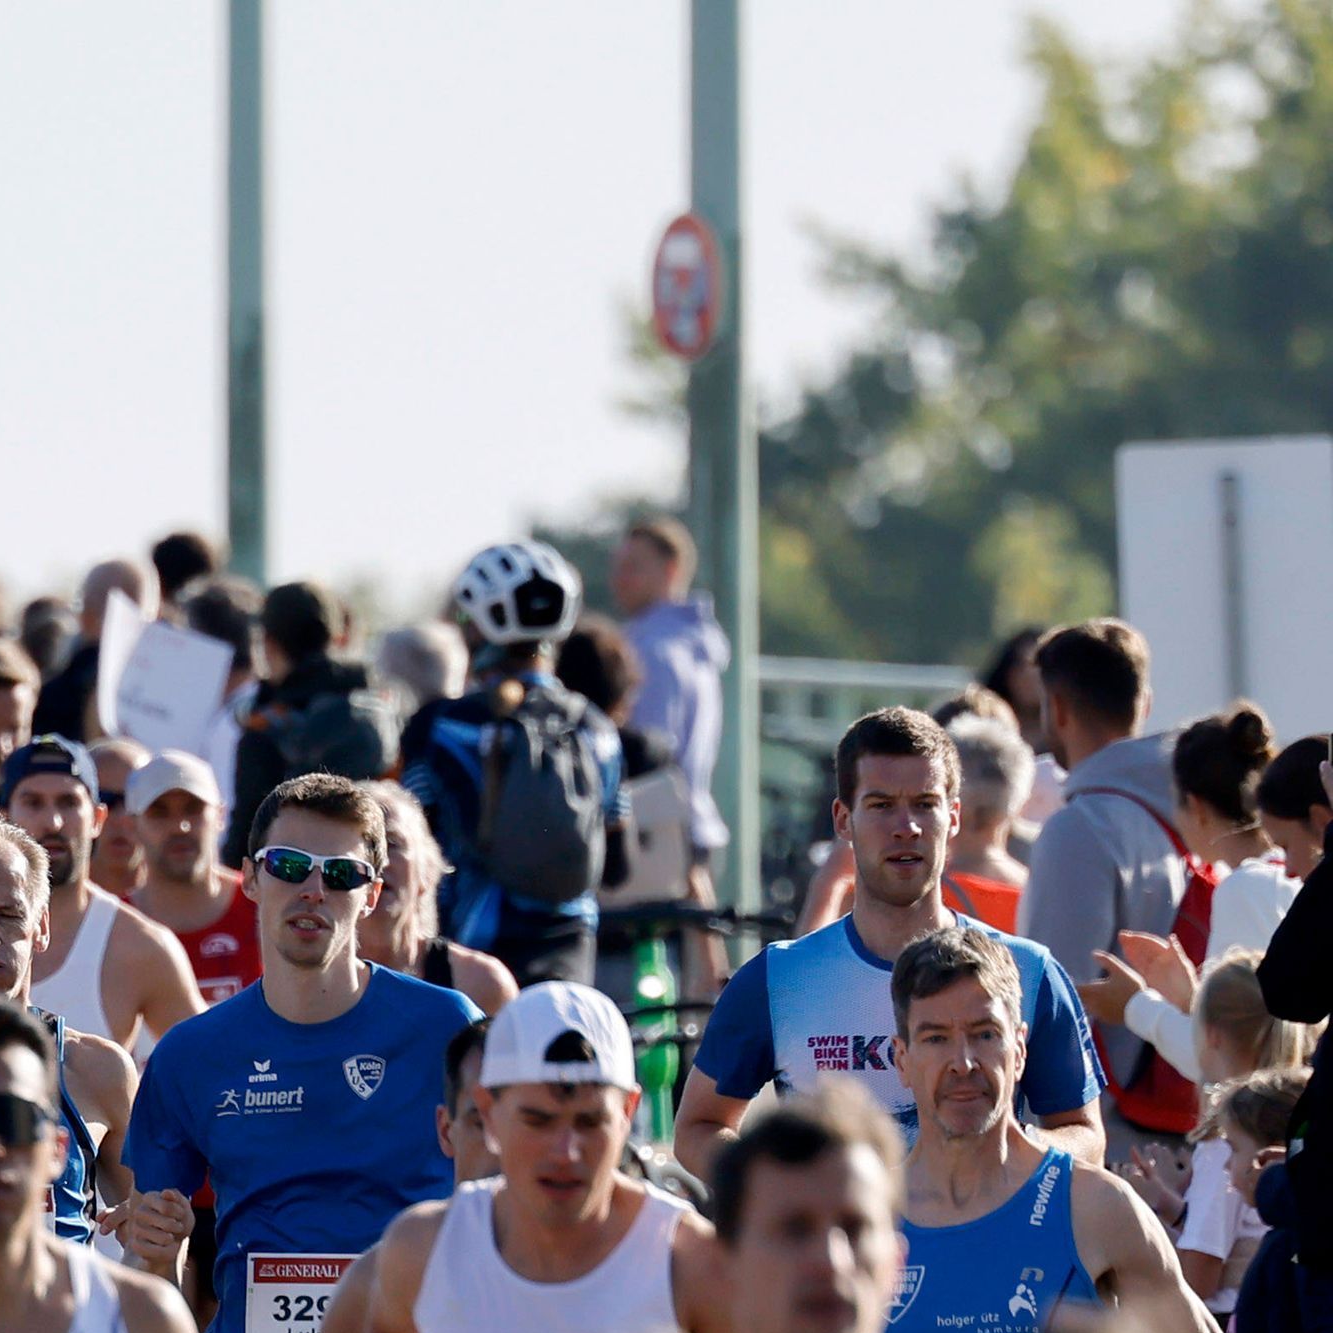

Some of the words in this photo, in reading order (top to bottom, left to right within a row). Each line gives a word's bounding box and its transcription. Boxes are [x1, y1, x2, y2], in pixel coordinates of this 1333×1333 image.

[807, 1036, 848, 1047] SWIM
[814, 1048, 848, 1059] BIKE
[816, 1060, 848, 1071] RUN
[248, 1073, 277, 1084] erima
[244, 1086, 304, 1107] bunert
[1029, 1166, 1061, 1226] newline
[276, 1263, 341, 1279] GENERALI
[937, 1314, 975, 1328] holger
[981, 1312, 999, 1323] ütz
